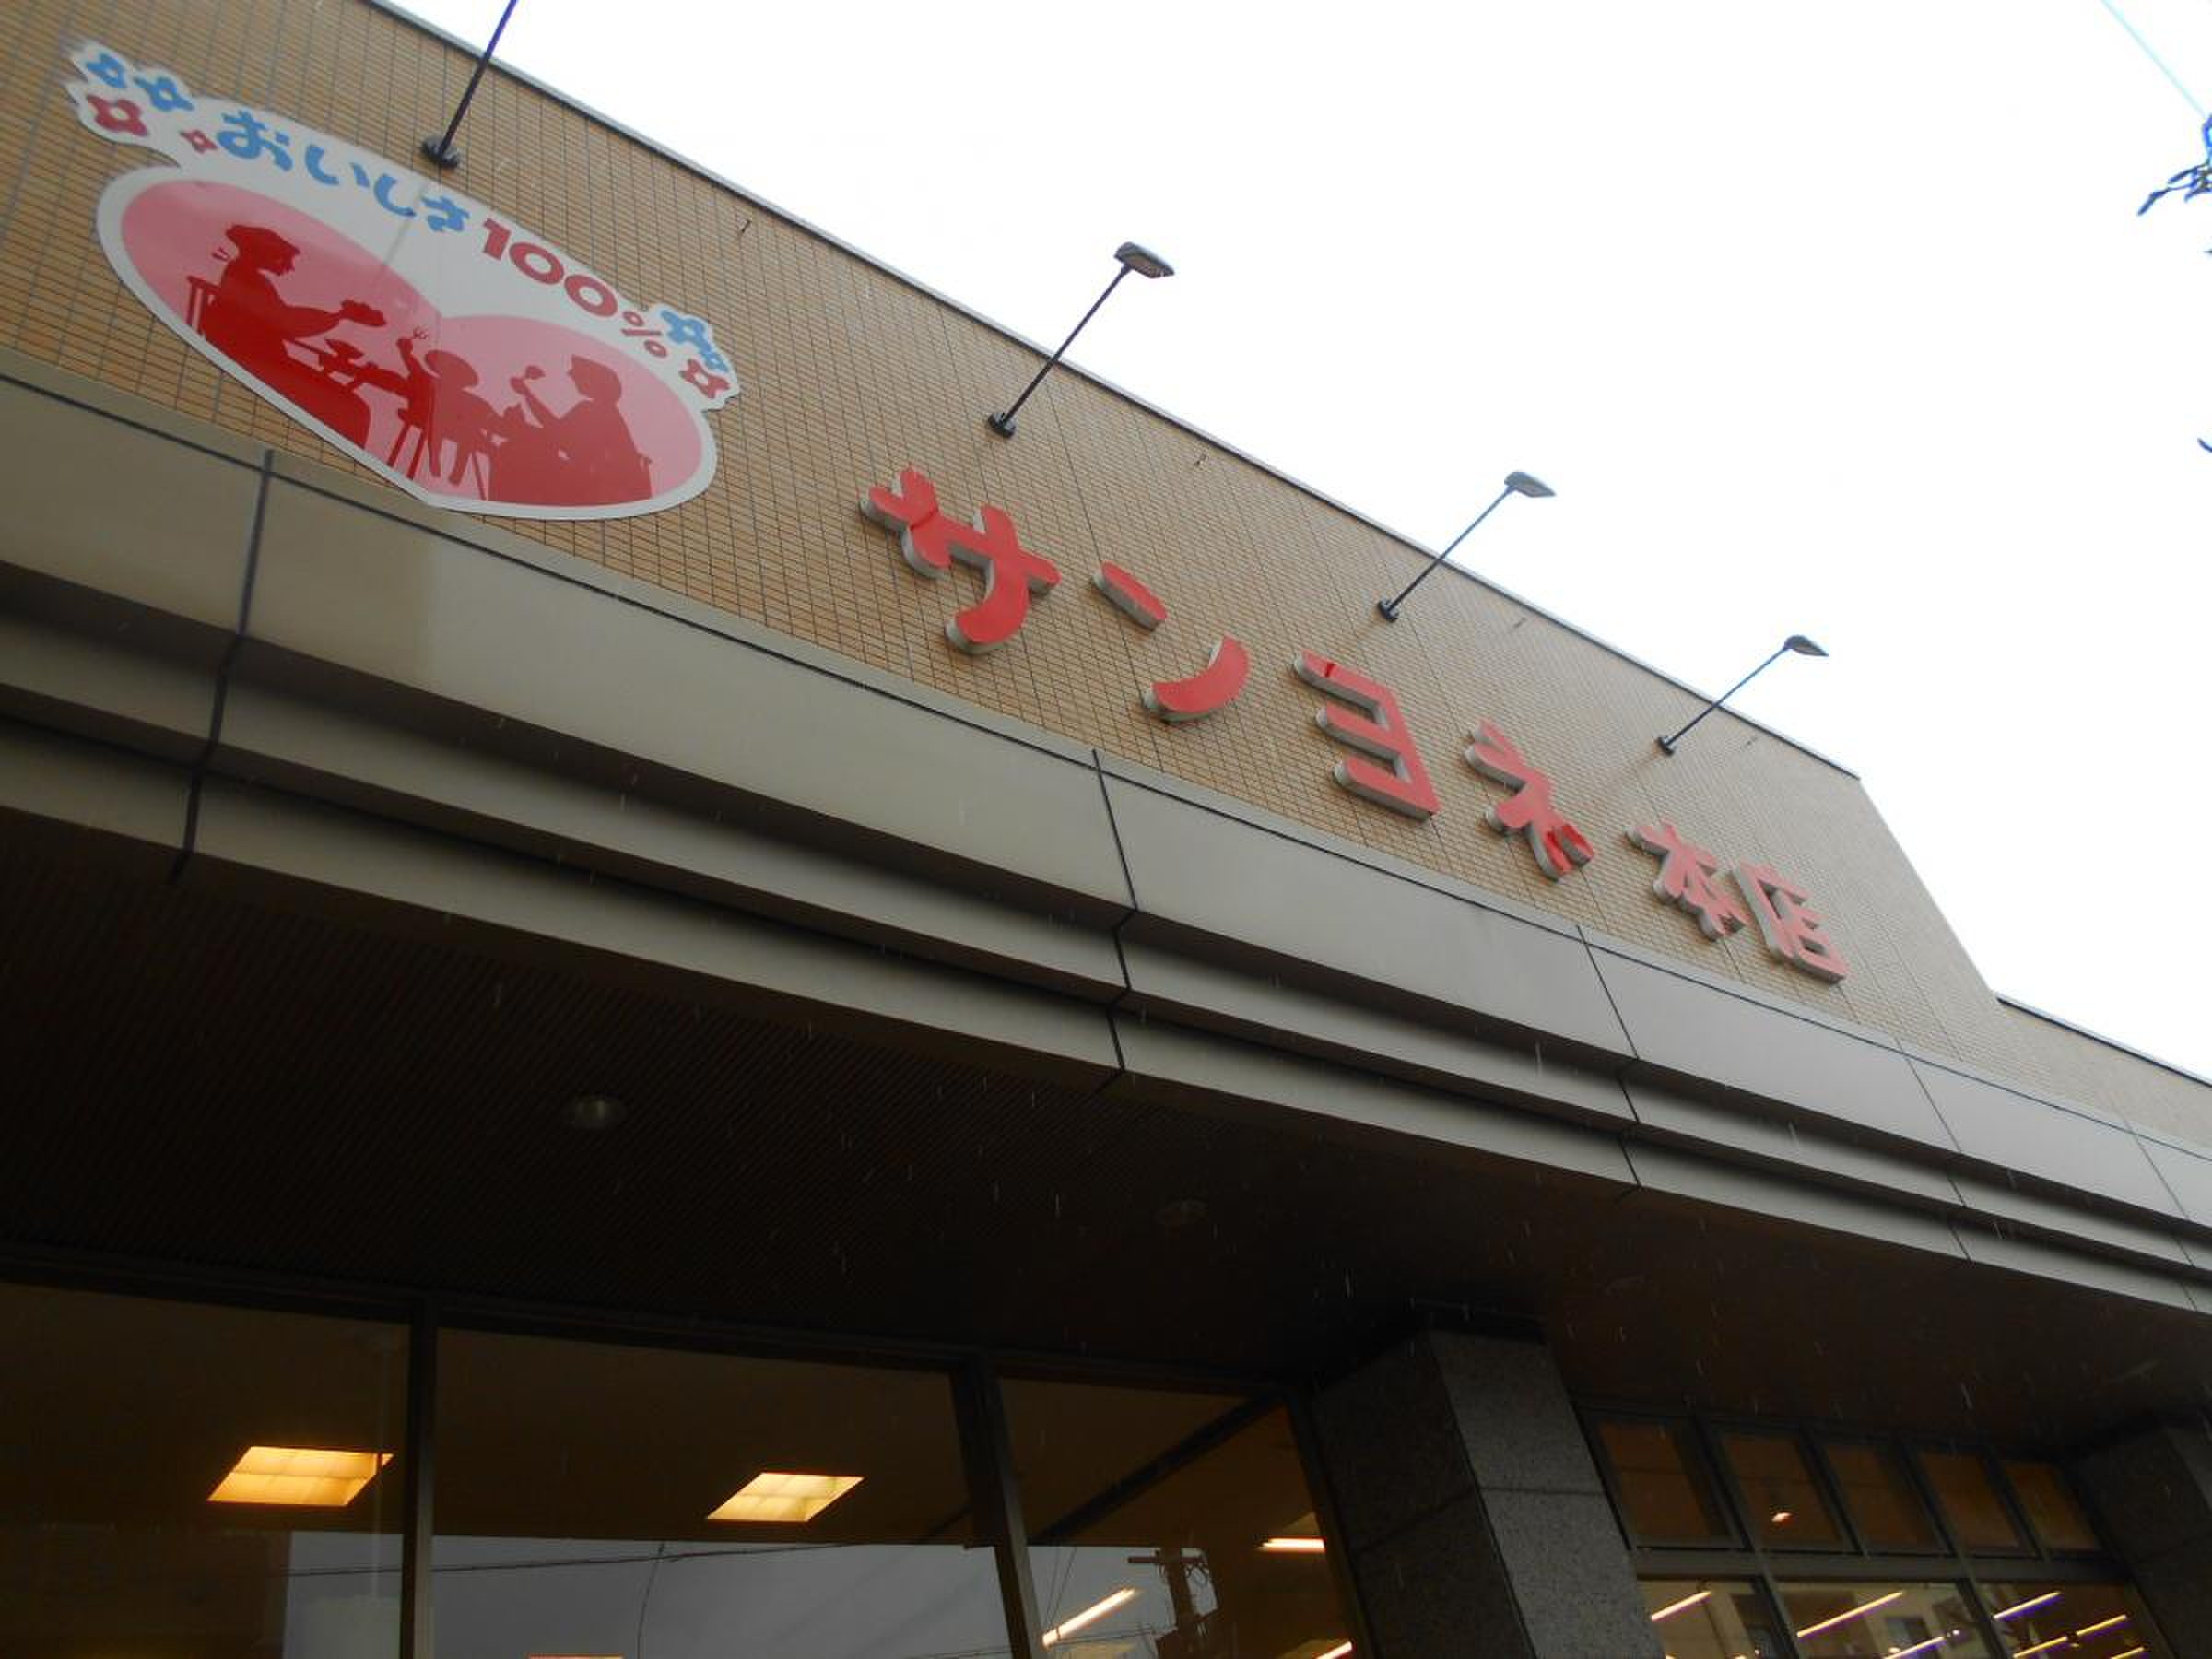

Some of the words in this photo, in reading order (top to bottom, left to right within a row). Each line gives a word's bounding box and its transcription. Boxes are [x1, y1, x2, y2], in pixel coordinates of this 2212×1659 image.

[860, 464, 1594, 881] サンヨネ
[1625, 818, 1847, 983] 本店
